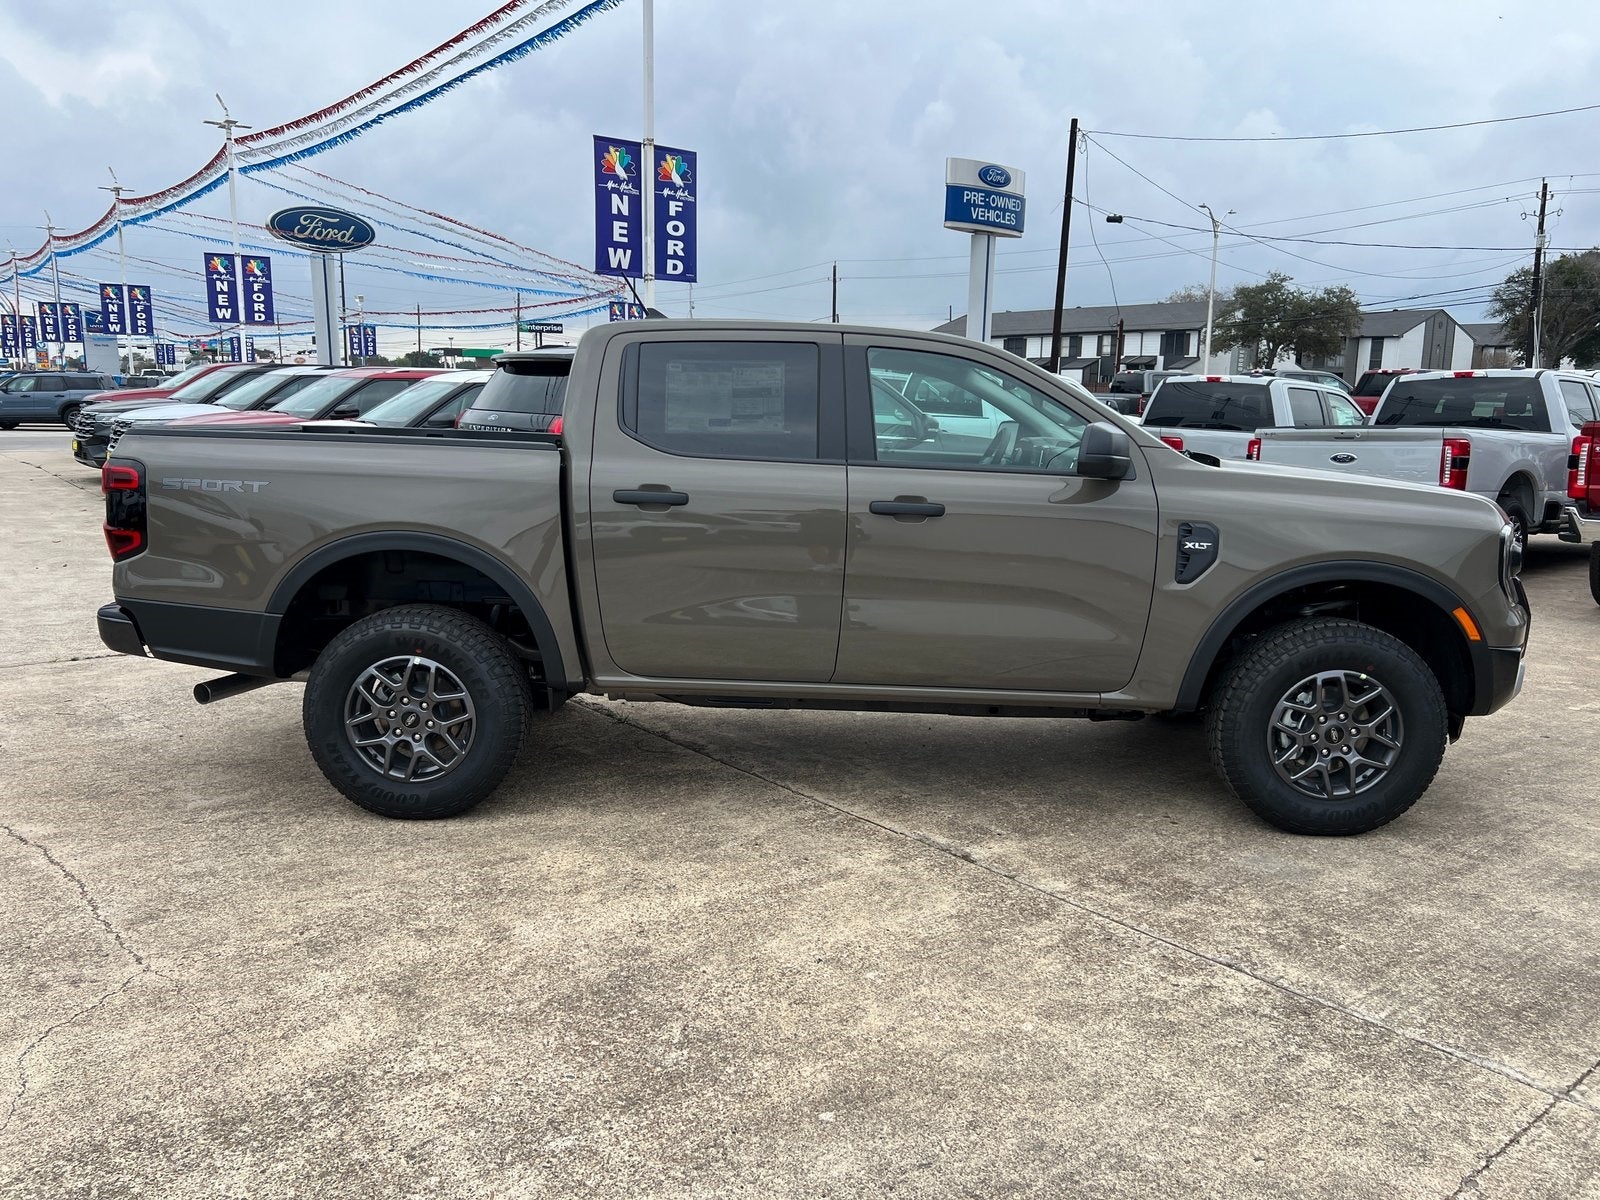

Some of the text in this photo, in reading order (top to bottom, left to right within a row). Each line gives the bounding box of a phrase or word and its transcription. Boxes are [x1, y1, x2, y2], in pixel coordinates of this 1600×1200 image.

[987, 168, 1005, 184] Ford
[971, 206, 1016, 225] VEHICLES
[294, 213, 355, 243] Ford
[607, 193, 632, 270] NEW
[666, 200, 686, 275] FORD
[215, 280, 232, 319] NEW
[252, 283, 266, 322] FORD
[108, 303, 121, 333] NEW
[136, 305, 147, 334] FORD
[520, 323, 562, 332] enterprise
[6, 327, 15, 346] NEW
[24, 328, 33, 347] FORD
[45, 317, 56, 341] NEW
[67, 318, 77, 342] FORD
[352, 337, 360, 355] NEW
[467, 423, 513, 432] EXPEDITION
[161, 477, 272, 493] SPORT
[1183, 541, 1213, 550] XLT
